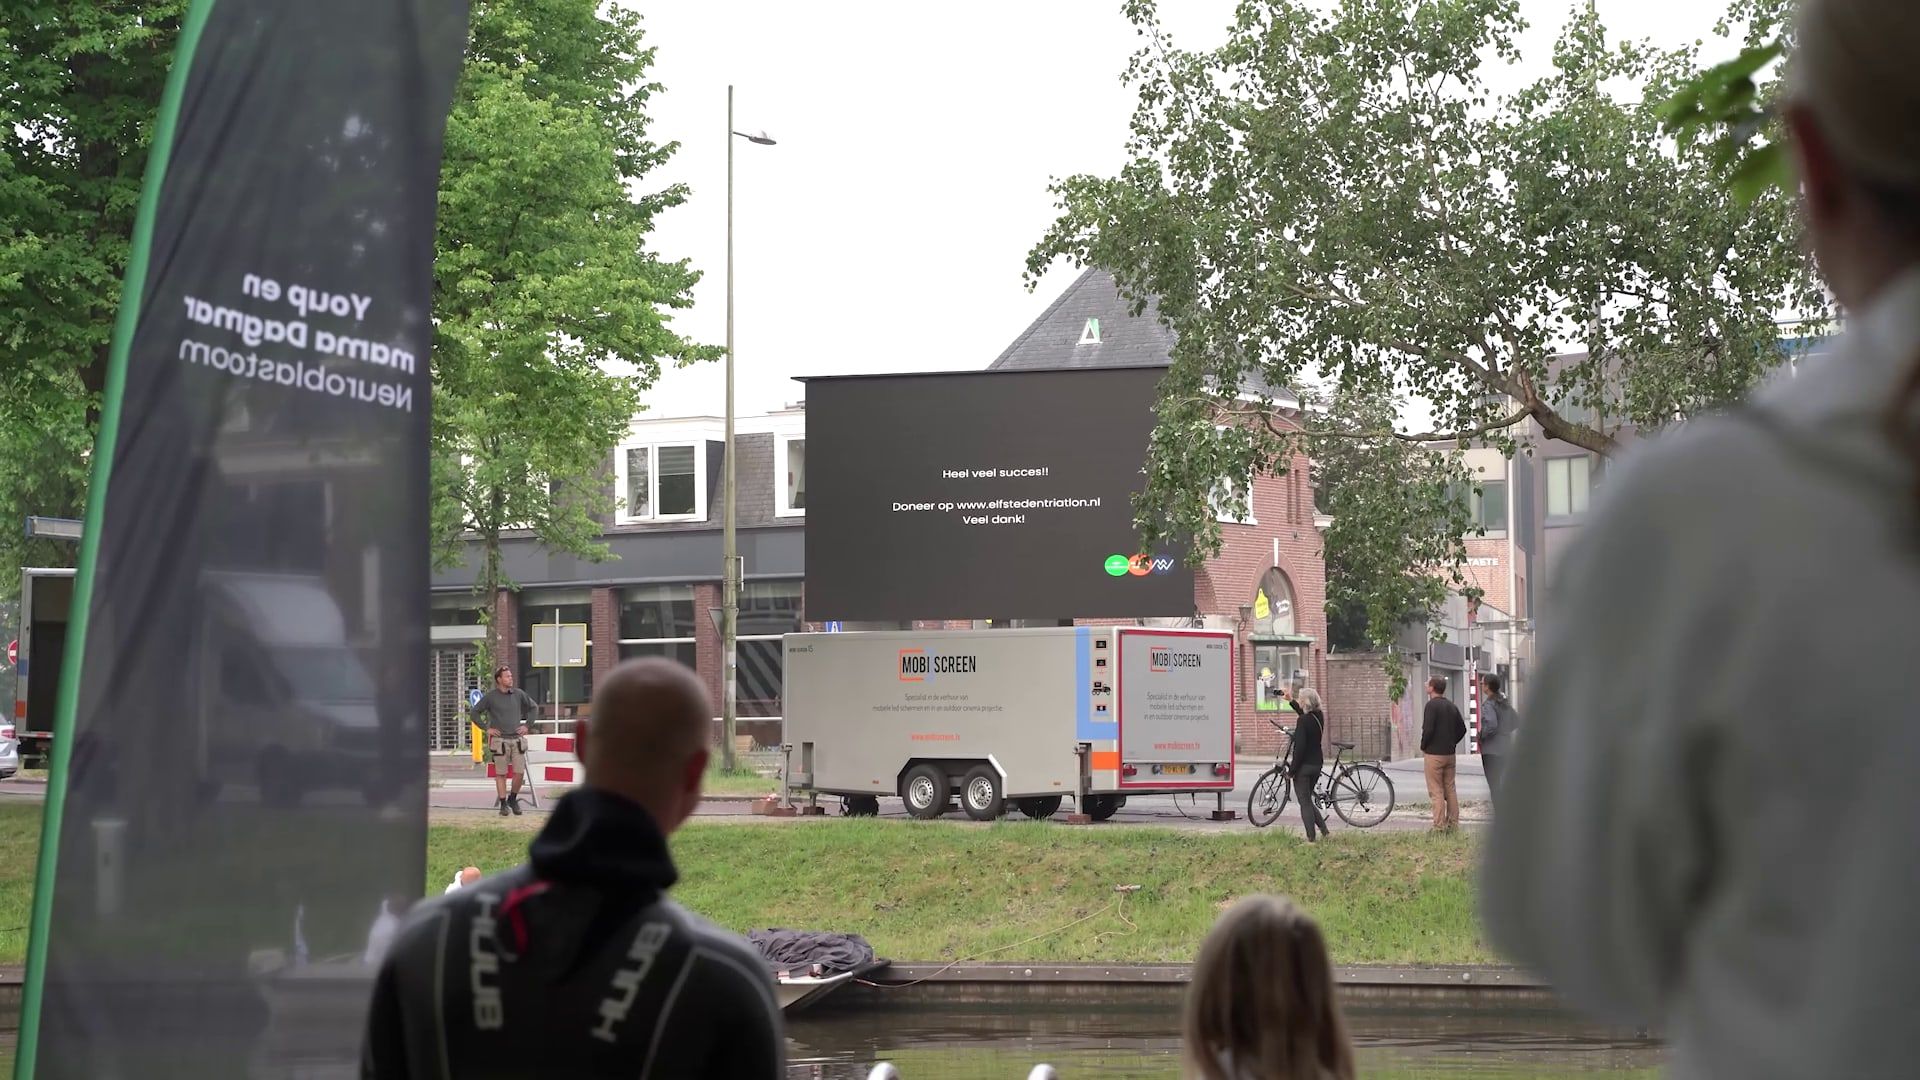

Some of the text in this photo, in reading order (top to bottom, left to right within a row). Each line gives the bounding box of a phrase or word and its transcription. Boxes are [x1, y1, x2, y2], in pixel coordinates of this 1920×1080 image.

[942, 467, 1049, 479] Heel veel succes!!
[892, 497, 1101, 513] Doneer op www.elfstedentriatlon.nl
[962, 514, 1025, 525] Veel dank!
[902, 655, 977, 674] MOBI SCREEN
[1152, 652, 1201, 668] MOBI SCREEN
[469, 892, 504, 1030] HUUB
[591, 922, 672, 1043] HUUB
